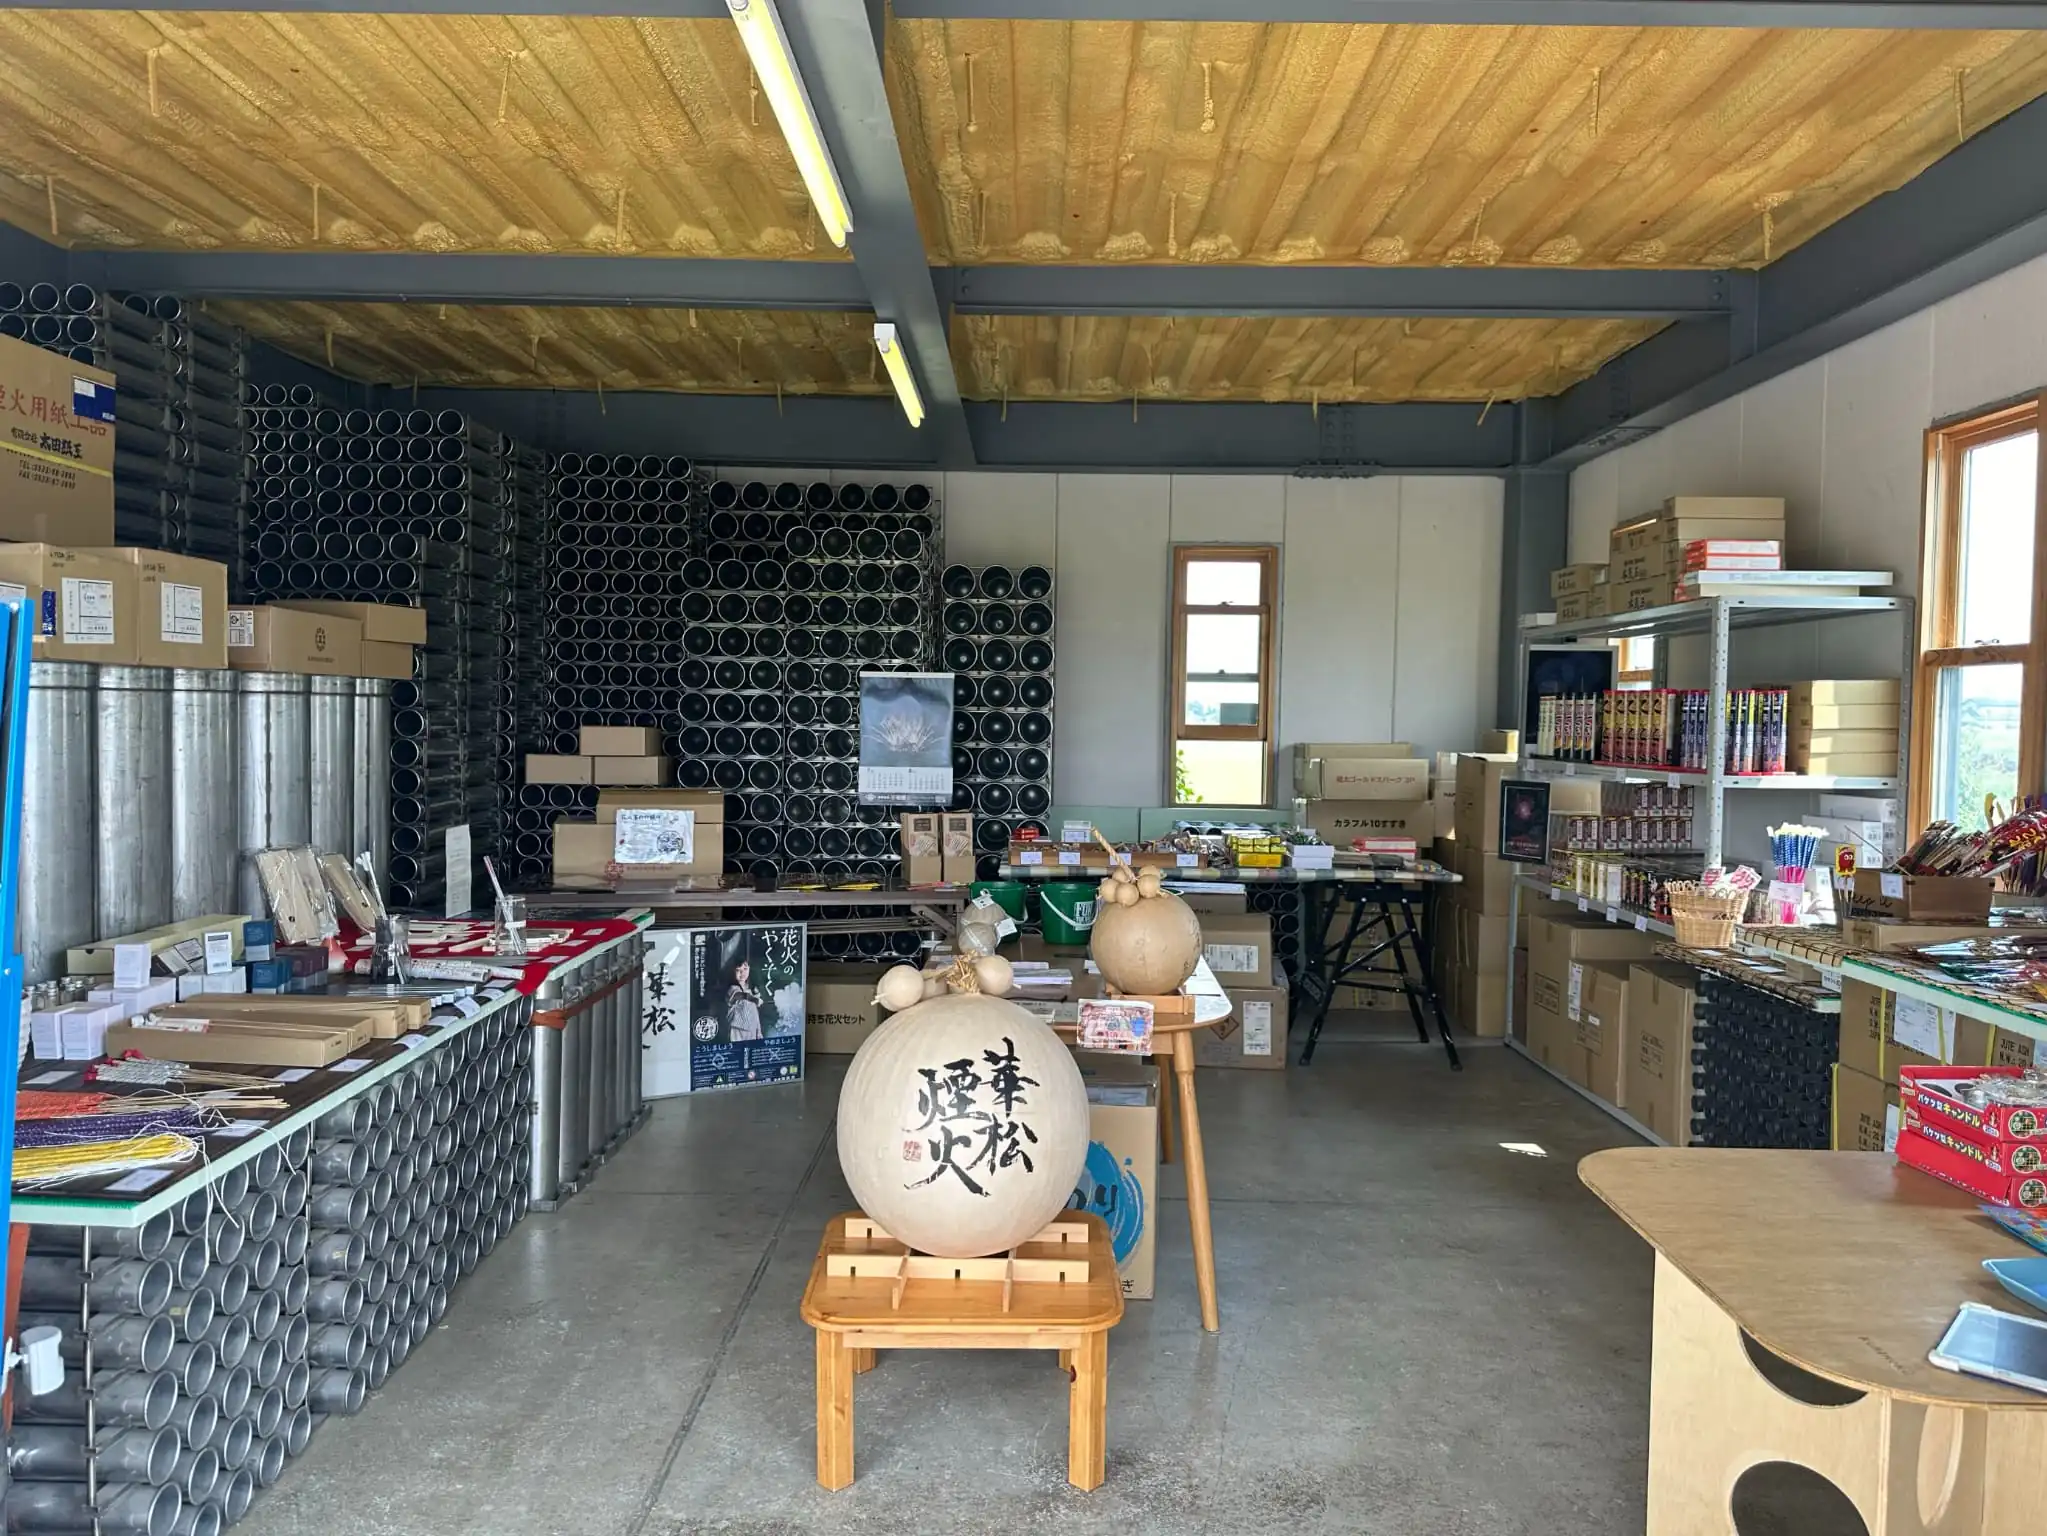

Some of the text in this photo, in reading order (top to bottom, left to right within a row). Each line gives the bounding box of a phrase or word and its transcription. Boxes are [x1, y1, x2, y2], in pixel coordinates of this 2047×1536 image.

[761, 930, 779, 997] やくそく
[780, 927, 799, 976] 花火の
[808, 1013, 866, 1025] 持ち花火セット
[902, 1058, 991, 1197] 煙火
[965, 1037, 1040, 1176] 華松
[1918, 1093, 1981, 1127] バケツ型キャンドル
[1922, 1125, 1984, 1162] バケツ型キャンドル
